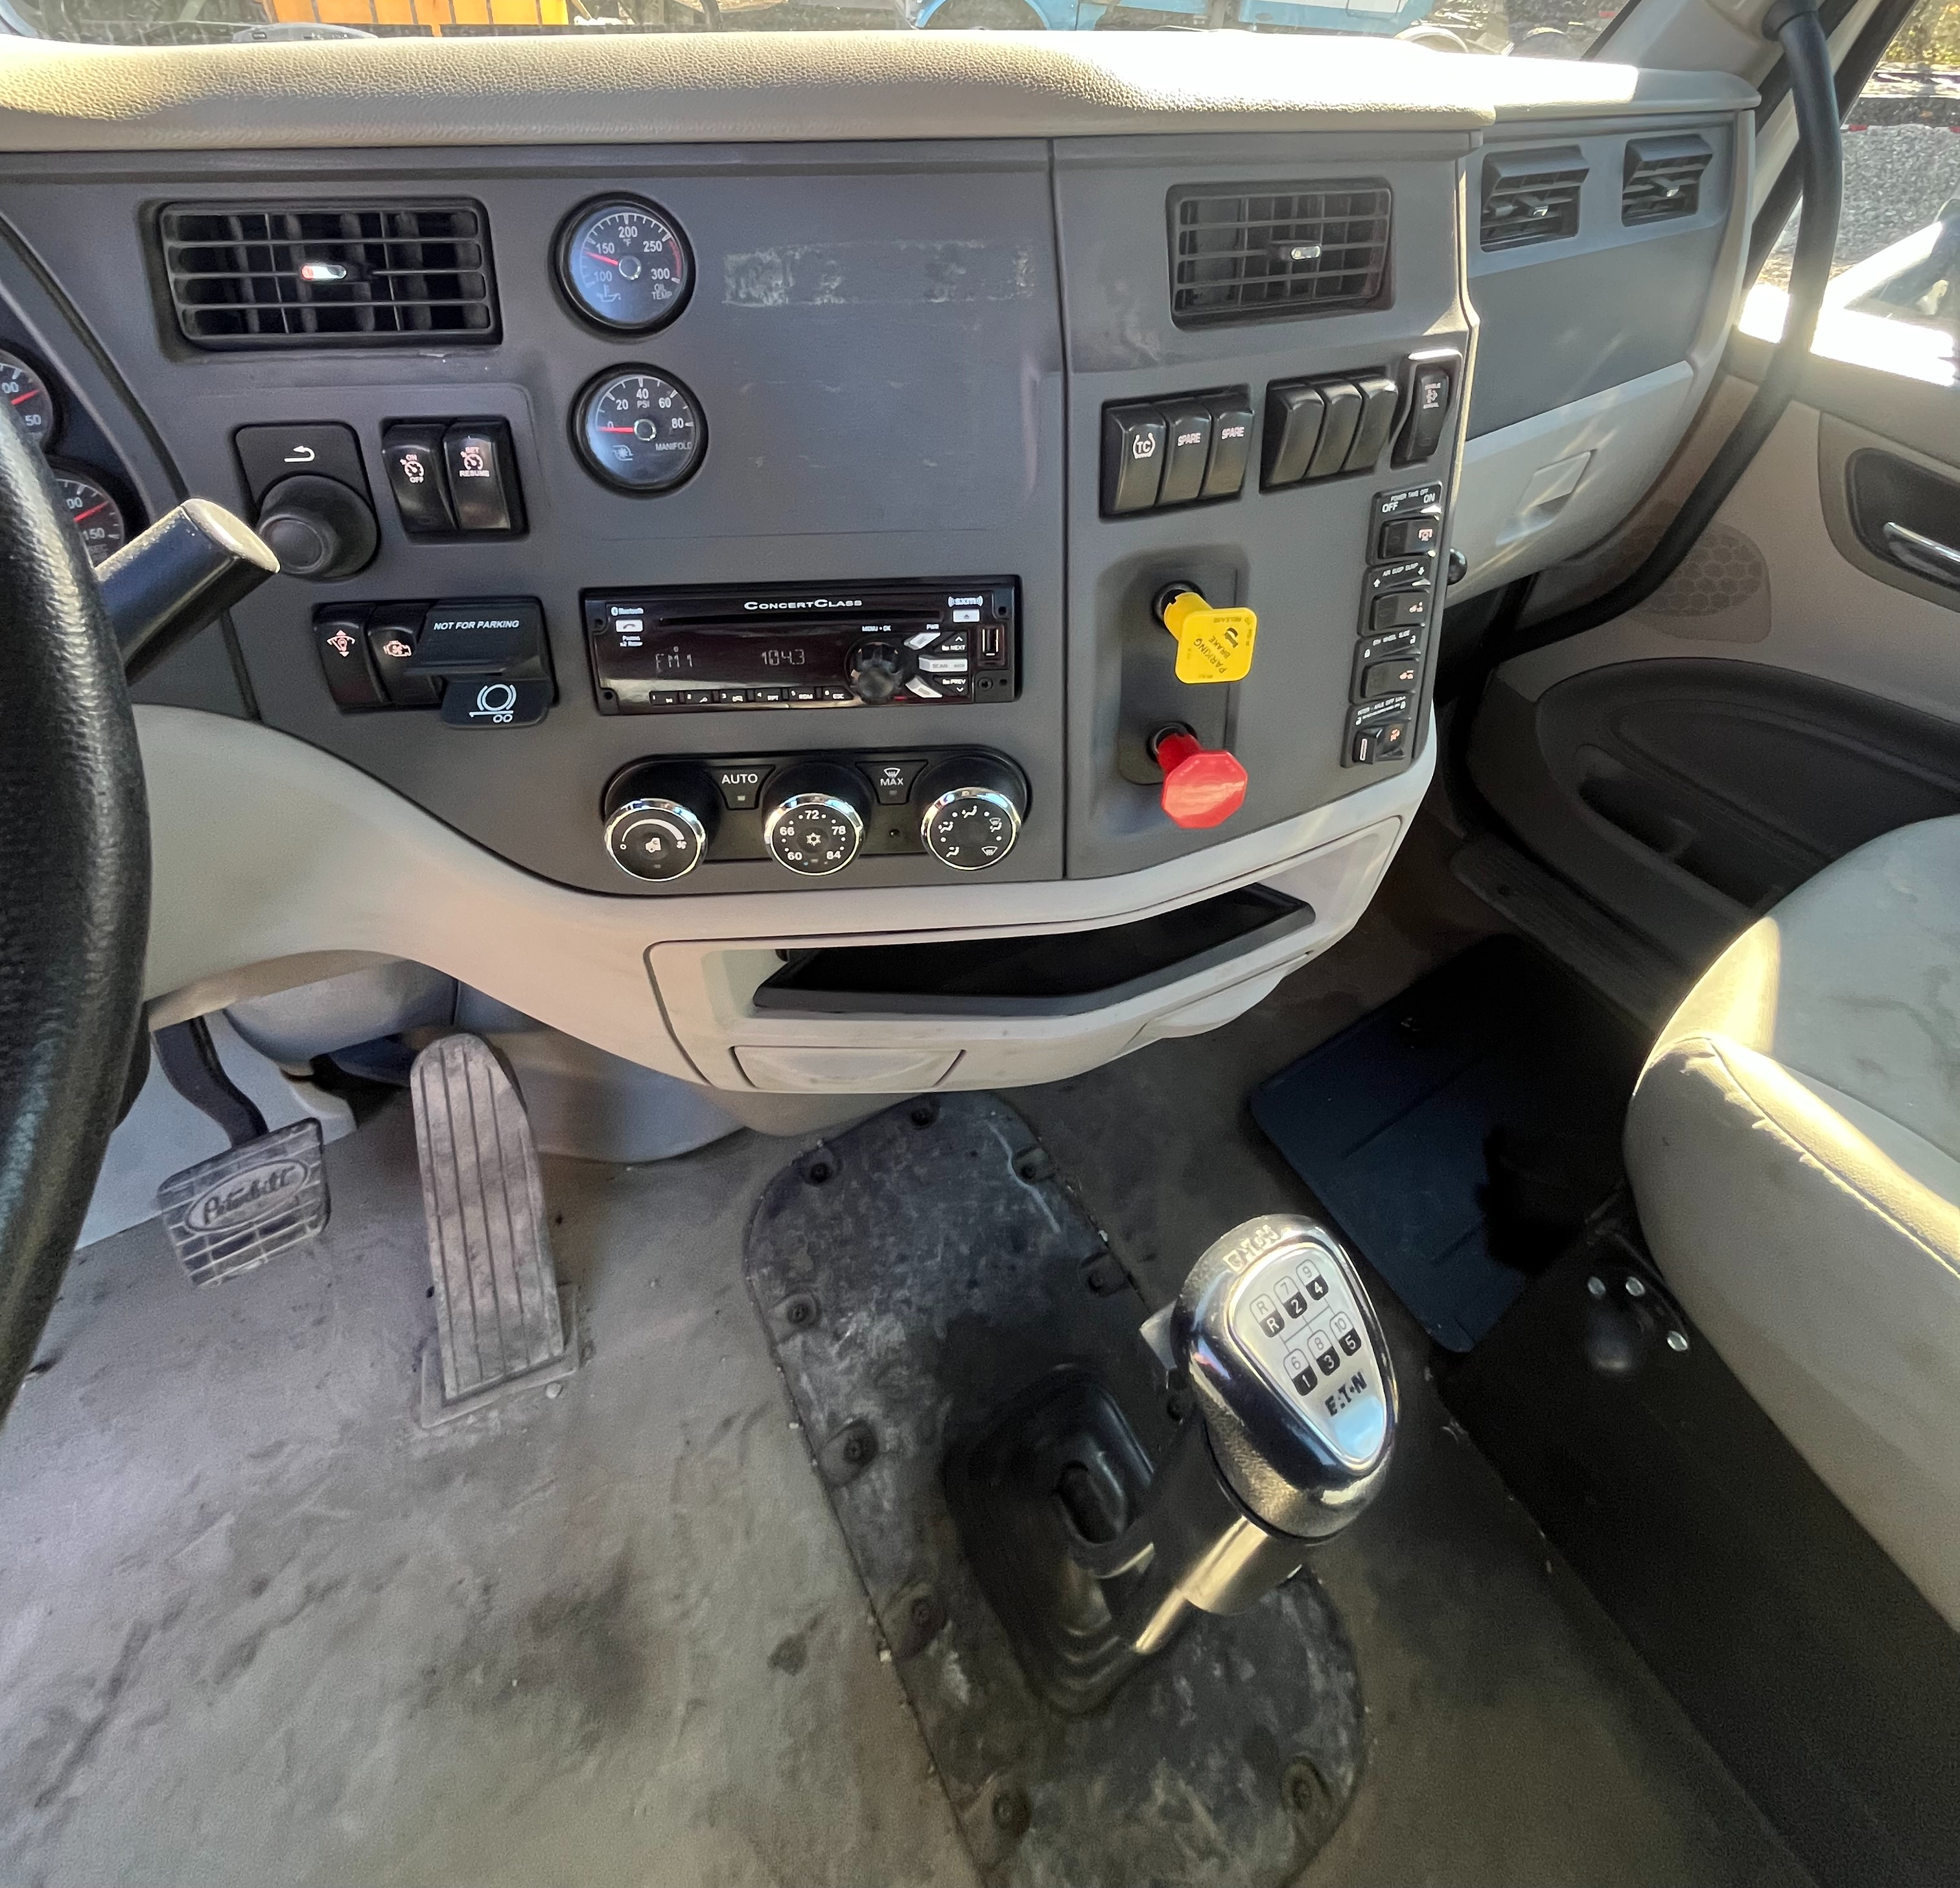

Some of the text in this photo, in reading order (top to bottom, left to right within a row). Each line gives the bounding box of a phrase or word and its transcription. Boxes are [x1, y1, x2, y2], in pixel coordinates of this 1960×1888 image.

[618, 226, 638, 238] 200
[596, 243, 615, 255] 150
[643, 240, 663, 252] 250
[594, 271, 612, 282] 100
[651, 268, 670, 280] 300
[651, 290, 672, 299] TEMP
[1, 382, 19, 393] 00
[636, 388, 649, 400] 40
[616, 399, 629, 410] 20
[659, 398, 671, 409] 60
[671, 418, 684, 429] 80
[1221, 426, 1245, 440] SPARE
[1177, 432, 1201, 447] SPARE
[655, 442, 692, 451] MANIFOLD
[1137, 441, 1151, 454] TC
[67, 497, 83, 509] 00
[1423, 493, 1436, 504] ON
[1382, 502, 1399, 513] OFF
[83, 528, 105, 539] 150
[434, 620, 519, 631] NOT FOR PARKING
[1208, 636, 1230, 659] BRAKE
[1193, 638, 1227, 674] PARKING
[721, 773, 758, 785] AUTO
[880, 778, 904, 787] MAX
[805, 810, 819, 820] 72
[780, 826, 795, 836] 66
[832, 826, 846, 836] 78
[788, 851, 802, 861] 60
[826, 851, 841, 861] 84
[1303, 1266, 1312, 1278] 9
[1280, 1283, 1290, 1295] 7
[1313, 1281, 1324, 1294] 4
[1256, 1301, 1270, 1315] R
[1292, 1299, 1303, 1314] 2
[1266, 1318, 1280, 1333] R
[1334, 1318, 1348, 1331] 10
[1314, 1337, 1324, 1351] 8
[1346, 1336, 1357, 1349] 5
[1292, 1358, 1301, 1371] 6
[1324, 1355, 1335, 1368] 3
[1301, 1375, 1312, 1388] 1
